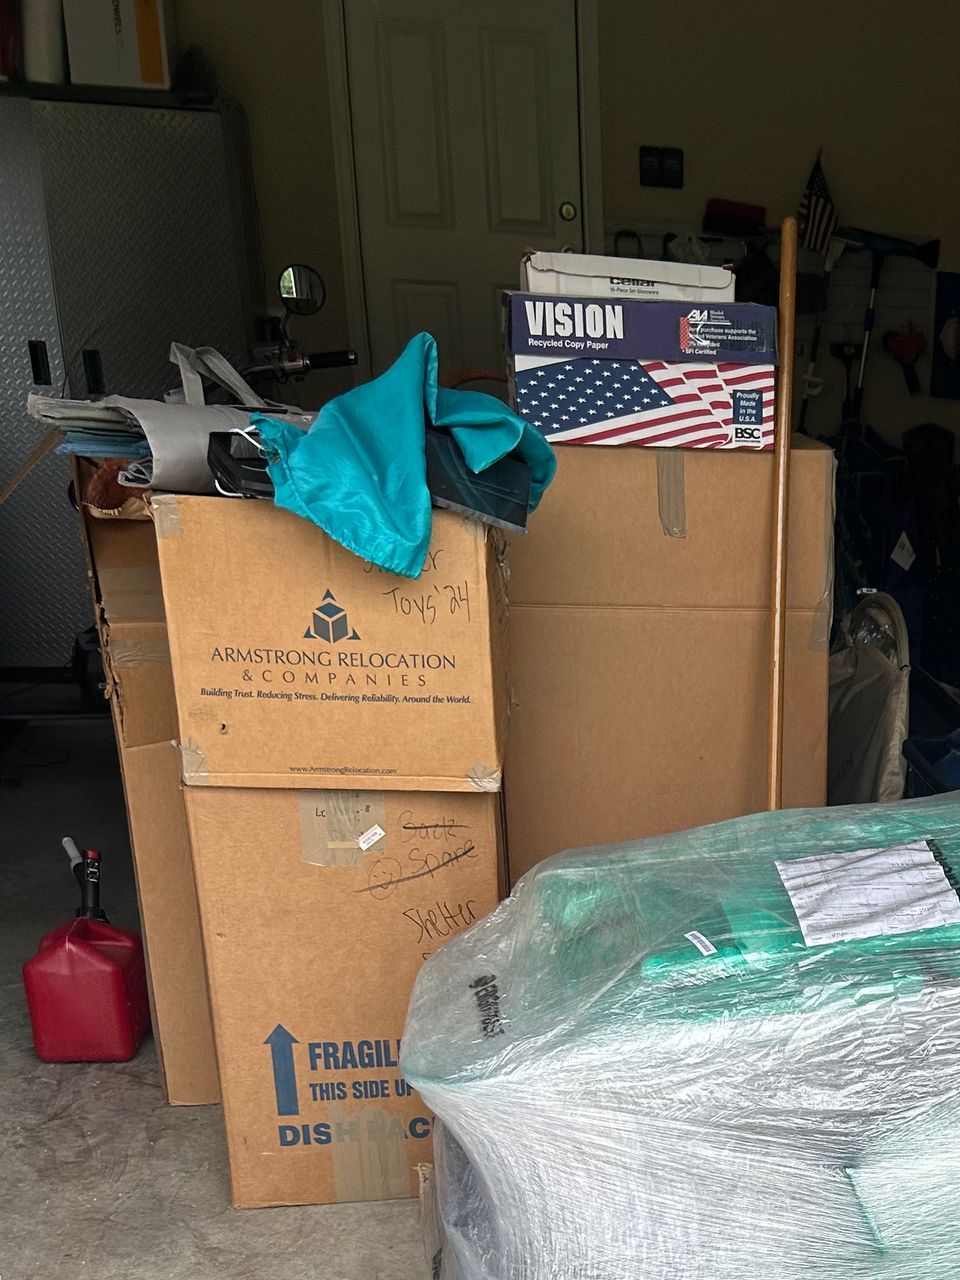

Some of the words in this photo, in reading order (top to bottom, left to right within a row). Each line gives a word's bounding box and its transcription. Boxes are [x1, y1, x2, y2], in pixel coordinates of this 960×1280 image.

[525, 301, 624, 339] VISION
[700, 326, 723, 334] purchase
[528, 338, 563, 349] Recycled
[564, 340, 585, 350] Copy
[586, 341, 609, 351] Paper
[736, 391, 760, 401] Proudly
[735, 427, 761, 440] BSC
[383, 587, 436, 625] Toys
[211, 646, 332, 667] ARMSTRONG
[337, 652, 456, 670] RELOCATION
[242, 669, 253, 682] &
[261, 669, 426, 687] COMPANIES
[200, 687, 232, 700] Building
[234, 688, 255, 698] Trust.
[257, 690, 292, 702] Reducing
[294, 691, 318, 700] Stress.
[320, 692, 360, 704] Delivering
[361, 694, 400, 705] Reliability.
[402, 695, 431, 704] Around
[432, 695, 445, 704] the
[446, 695, 471, 704] World.
[288, 766, 397, 775] www.ArmstrongRelocation.com
[402, 899, 476, 944] Shelter
[308, 1039, 402, 1071] FRAGIL
[309, 1081, 348, 1102] THIS
[352, 1079, 391, 1100] SIDE
